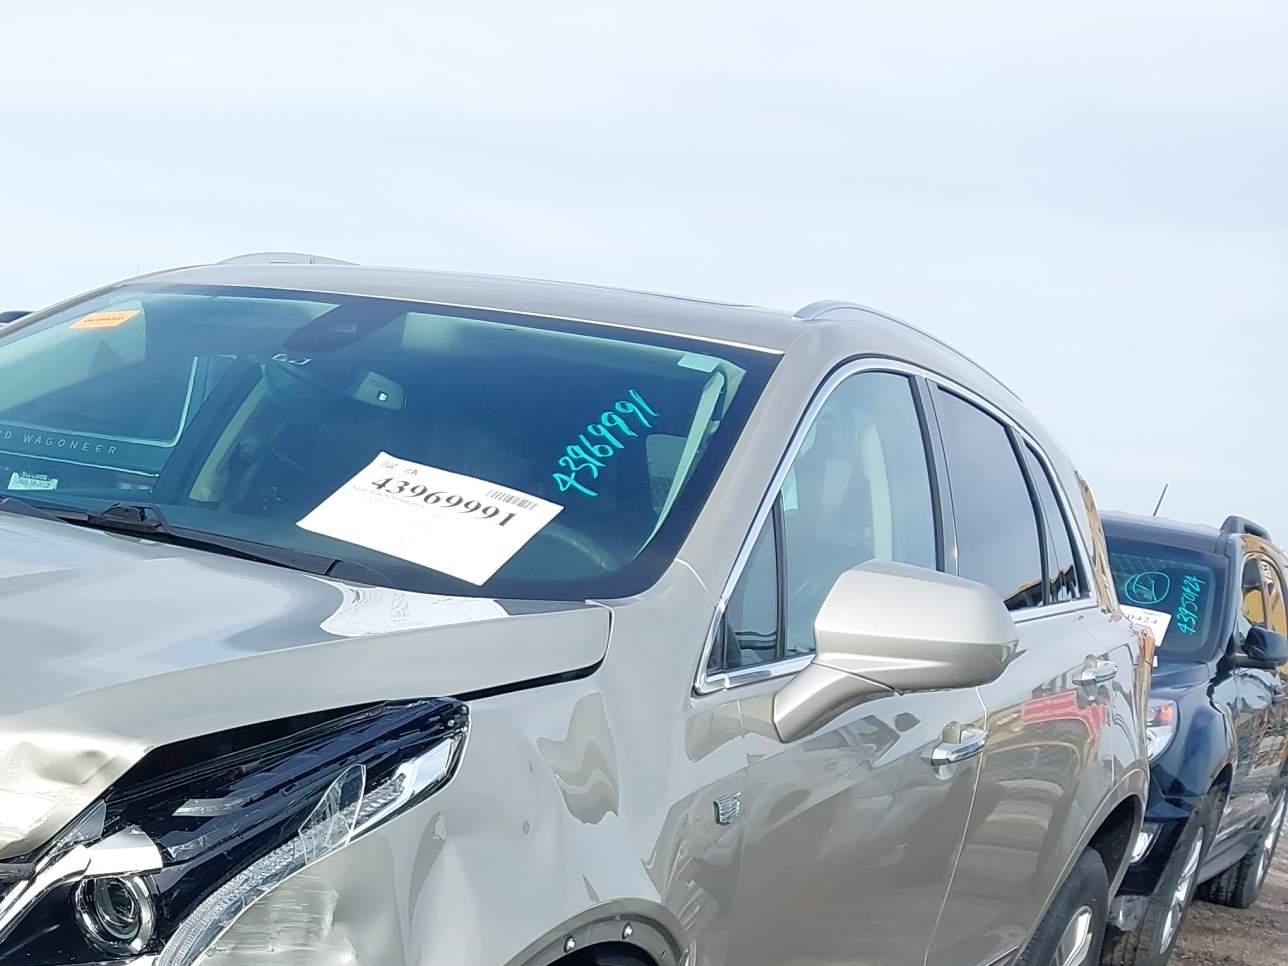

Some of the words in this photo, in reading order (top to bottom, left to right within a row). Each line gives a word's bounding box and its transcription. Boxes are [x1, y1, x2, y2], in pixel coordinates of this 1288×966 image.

[23, 433, 117, 455] WAGONEER
[552, 388, 659, 497] 43969991
[371, 476, 517, 527] 43969991
